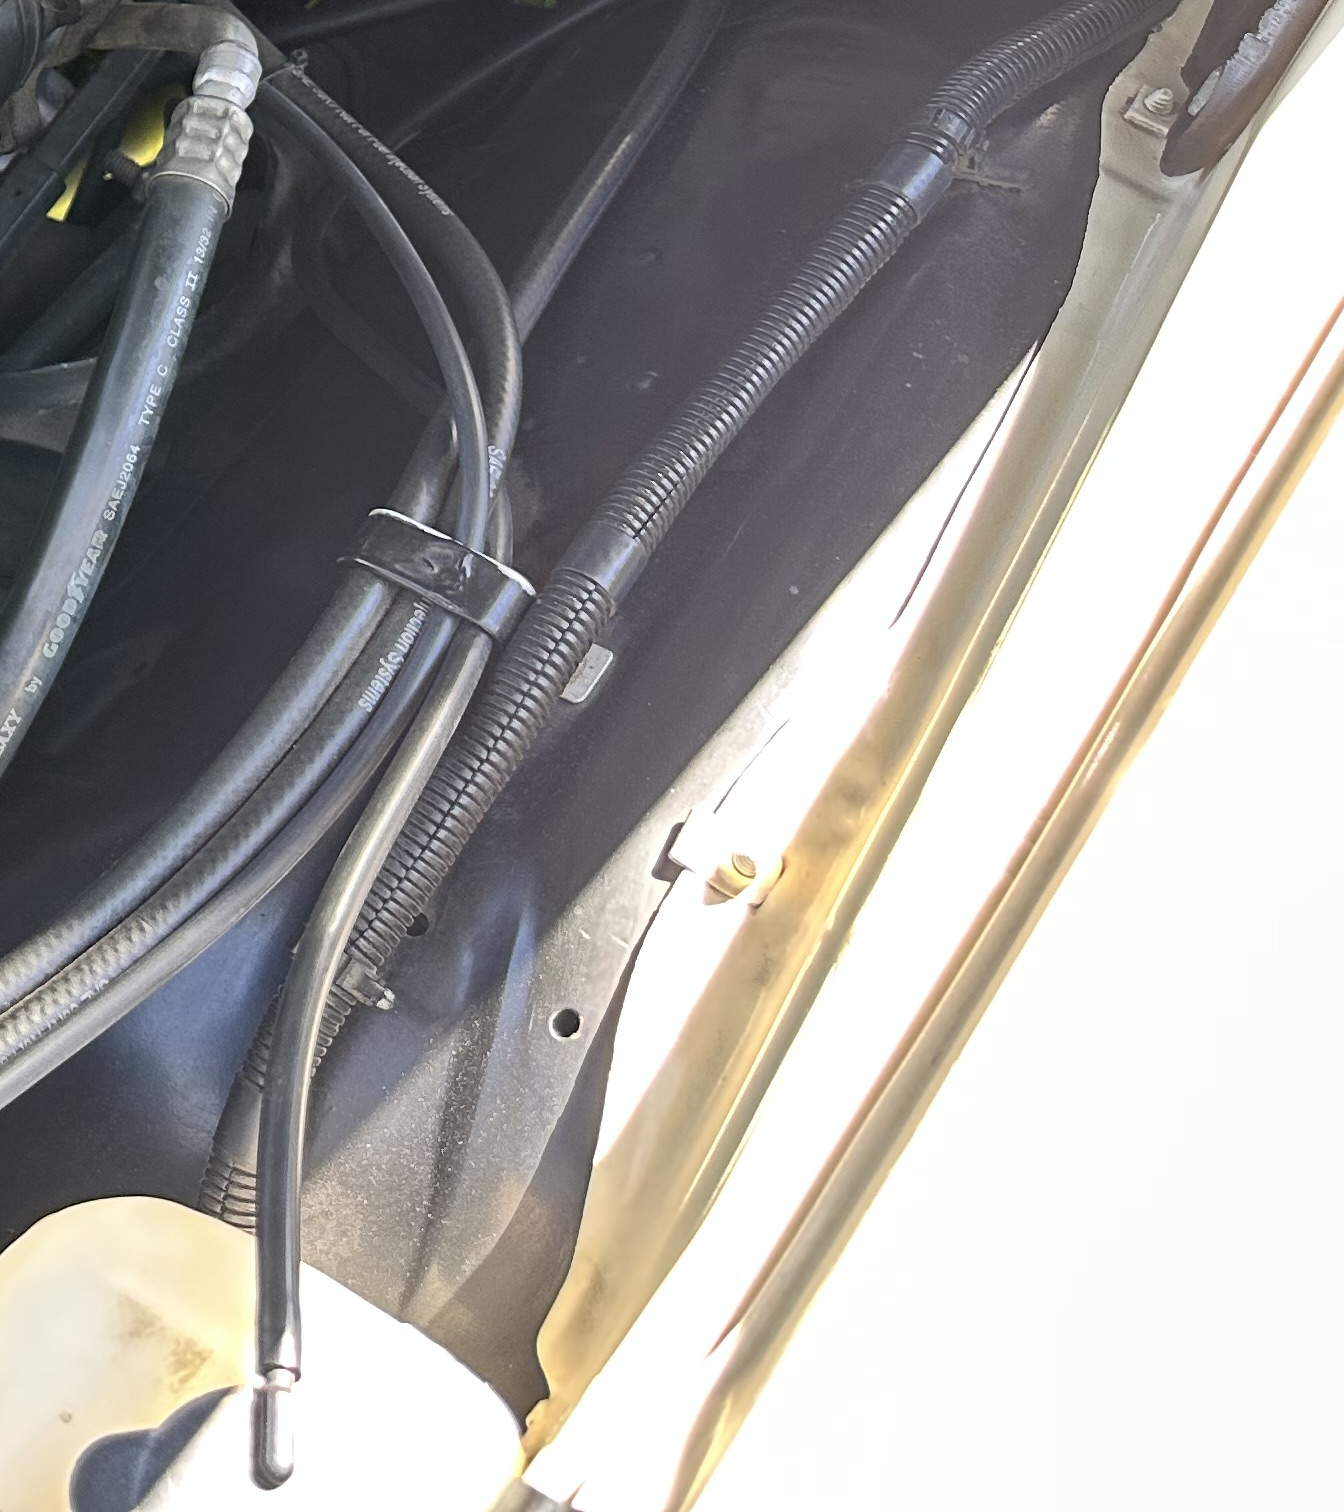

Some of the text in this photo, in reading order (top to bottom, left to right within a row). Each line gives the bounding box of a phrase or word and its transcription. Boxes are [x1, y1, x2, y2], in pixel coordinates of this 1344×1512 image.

[23, 675, 43, 694] by
[42, 529, 108, 659] GOODYEAR
[102, 443, 141, 522] SAEJ2064
[137, 383, 162, 426] TYPE
[156, 363, 169, 376] C
[166, 295, 191, 348] CLASS
[194, 226, 214, 265] 13/32
[357, 648, 405, 713] Systems
